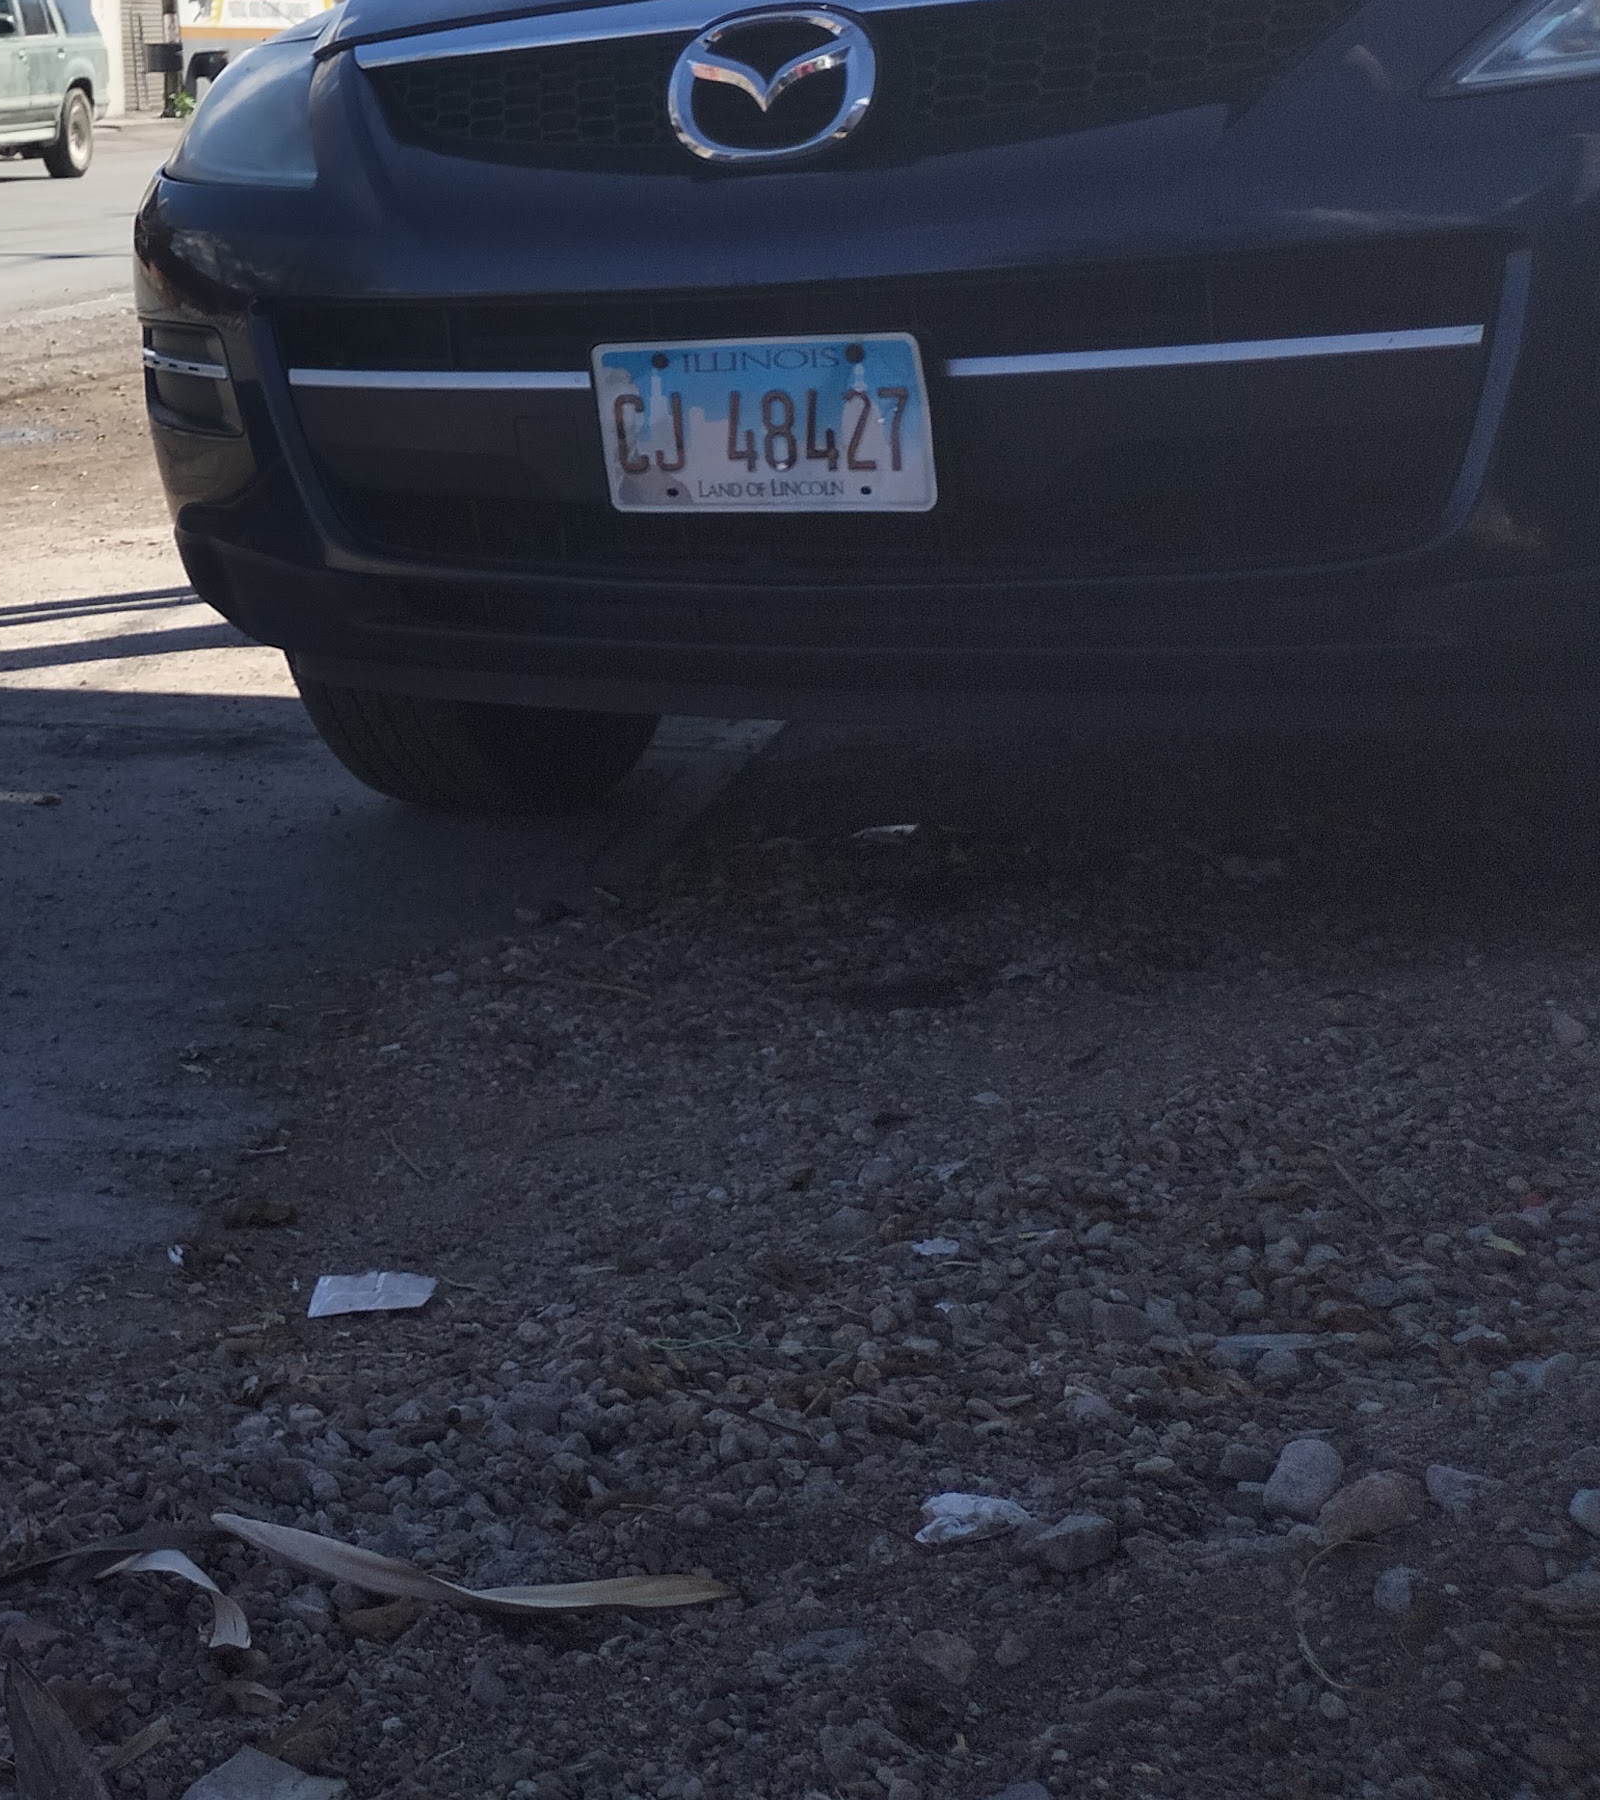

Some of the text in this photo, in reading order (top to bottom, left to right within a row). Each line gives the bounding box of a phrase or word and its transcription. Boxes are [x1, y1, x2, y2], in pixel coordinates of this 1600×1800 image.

[682, 347, 840, 374] ILLINOIS
[727, 386, 909, 473] 48427
[698, 480, 742, 498] LAND
[770, 478, 845, 498] LINCOLN
